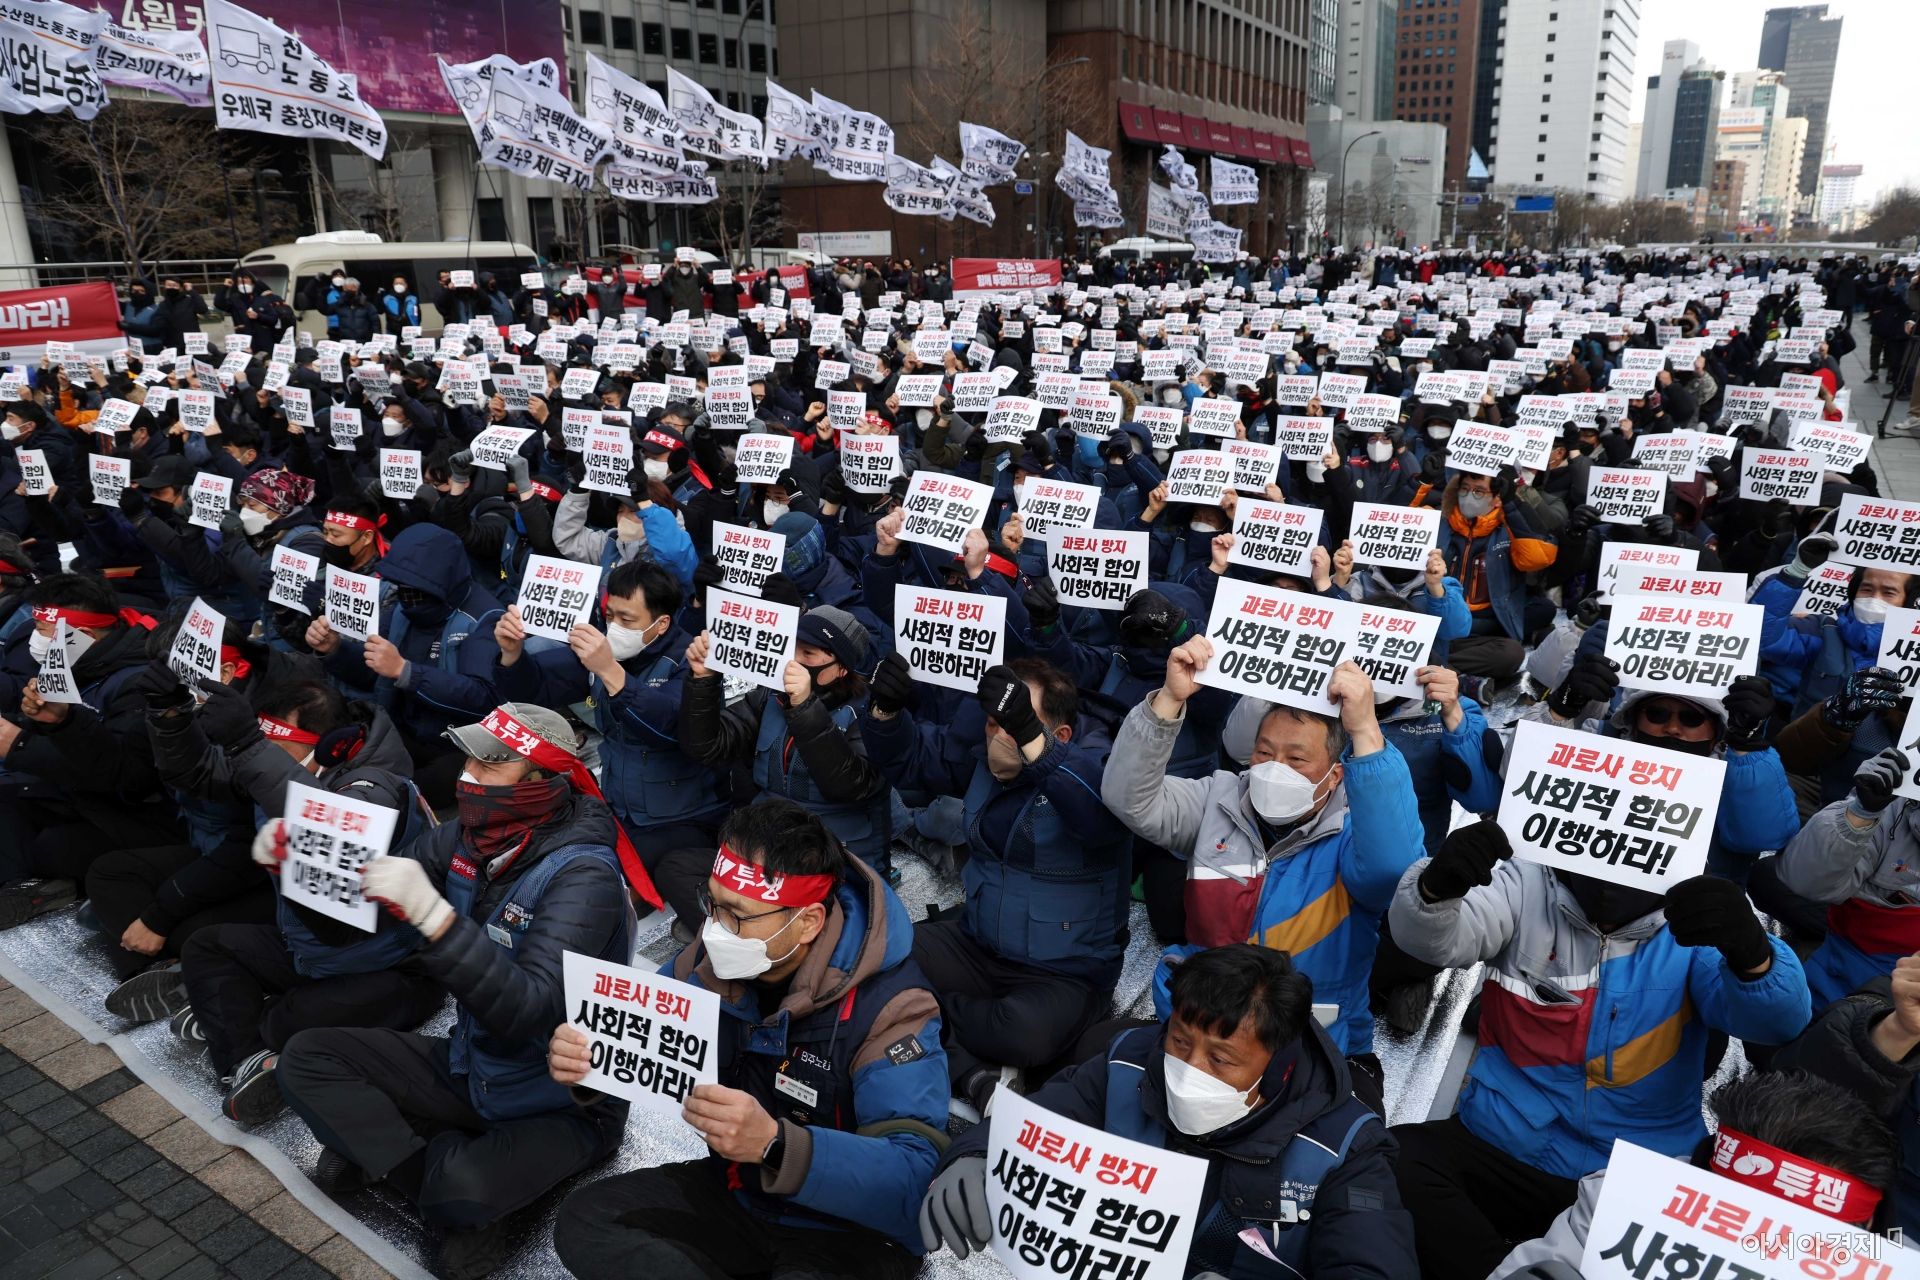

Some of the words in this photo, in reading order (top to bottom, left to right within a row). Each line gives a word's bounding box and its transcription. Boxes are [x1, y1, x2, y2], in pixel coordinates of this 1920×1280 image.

[1758, 456, 1785, 464] 과로사
[1790, 458, 1808, 466] 방지
[1602, 474, 1630, 484] 과로사
[1632, 476, 1650, 484] 방지
[1745, 466, 1785, 481] 사회적
[1788, 470, 1818, 484] 합의
[920, 480, 947, 494] 과로사
[949, 485, 972, 500] 방지
[1590, 486, 1628, 500] 사회적
[1632, 489, 1660, 502] 합의
[1751, 482, 1808, 498] 이행하라!
[905, 495, 944, 515] 사회적
[944, 503, 979, 524] 합의
[1252, 508, 1283, 520] 과로사
[1285, 513, 1304, 524] 방지
[1369, 512, 1399, 522] 과로사
[1402, 514, 1423, 524] 방지
[1593, 502, 1650, 518] 이행하라!
[1857, 504, 1899, 521] 과로사
[906, 515, 964, 542] 이행하라!
[1236, 522, 1280, 542] 사회적
[1282, 529, 1312, 548] 합의
[1354, 524, 1398, 541] 사회적
[1401, 529, 1432, 544] 합의
[1840, 519, 1896, 542] 사회적
[1063, 536, 1103, 552] 과로사
[1102, 540, 1126, 553] 방지
[1242, 542, 1302, 566] 이행하라!
[1360, 542, 1422, 561] 이행하라!
[1052, 553, 1099, 576] 사회적
[1104, 559, 1140, 579] 합의
[1618, 550, 1654, 562] 과로사
[1656, 553, 1680, 566] 방지
[333, 576, 353, 590] 과로사
[352, 582, 366, 592] 방지
[536, 564, 565, 580] 과로사
[564, 570, 582, 585] 방지
[1639, 576, 1686, 593] 과로사
[1690, 580, 1723, 596] 방지
[328, 589, 350, 610] 사회적
[353, 598, 374, 617] 합의
[522, 582, 558, 605] 사회적
[559, 589, 588, 611] 합의
[1060, 577, 1130, 603] 이행하라!
[331, 609, 368, 635] 이행하라!
[522, 605, 576, 636] 이행하라!
[720, 602, 752, 620] 과로사
[756, 609, 778, 626] 방지
[915, 597, 954, 617] 과로사
[957, 603, 983, 622] 방지
[1240, 596, 1294, 622] 과로사
[1296, 607, 1333, 629] 방지
[1638, 606, 1692, 624] 과로사
[1696, 611, 1732, 628] 방지
[710, 618, 752, 646] 사회적
[755, 630, 788, 655] 합의
[900, 618, 953, 647] 사회적
[958, 627, 996, 654] 합의
[1385, 617, 1416, 634] 방지
[1213, 617, 1290, 655] 사회적
[1292, 634, 1344, 668] 합의
[1380, 637, 1425, 662] 합의
[1614, 627, 1691, 654] 사회적
[1696, 634, 1750, 660] 합의
[715, 643, 778, 677] 이행하라!
[910, 647, 986, 682] 이행하라!
[1623, 654, 1733, 689] 이행하라!
[1220, 651, 1325, 696] 이행하라!
[1548, 743, 1624, 778] 과로사
[1628, 760, 1682, 790] 방지
[1512, 771, 1620, 821] 사회적
[1624, 795, 1702, 840] 합의
[1522, 813, 1675, 875] 이행하라!
[594, 973, 650, 1008] 과로사
[656, 991, 691, 1022] 방지
[574, 1000, 652, 1049] 사회적
[658, 1025, 708, 1072] 합의
[588, 1041, 694, 1104] 이행하라!
[1017, 1120, 1092, 1174] 과로사
[1096, 1154, 1158, 1194] 방지
[1714, 1131, 1740, 1170] 결
[1772, 1160, 1851, 1214] 투쟁
[992, 1148, 1086, 1226] 사회적
[1089, 1198, 1180, 1253] 합의
[999, 1203, 1155, 1279] 이행하라!
